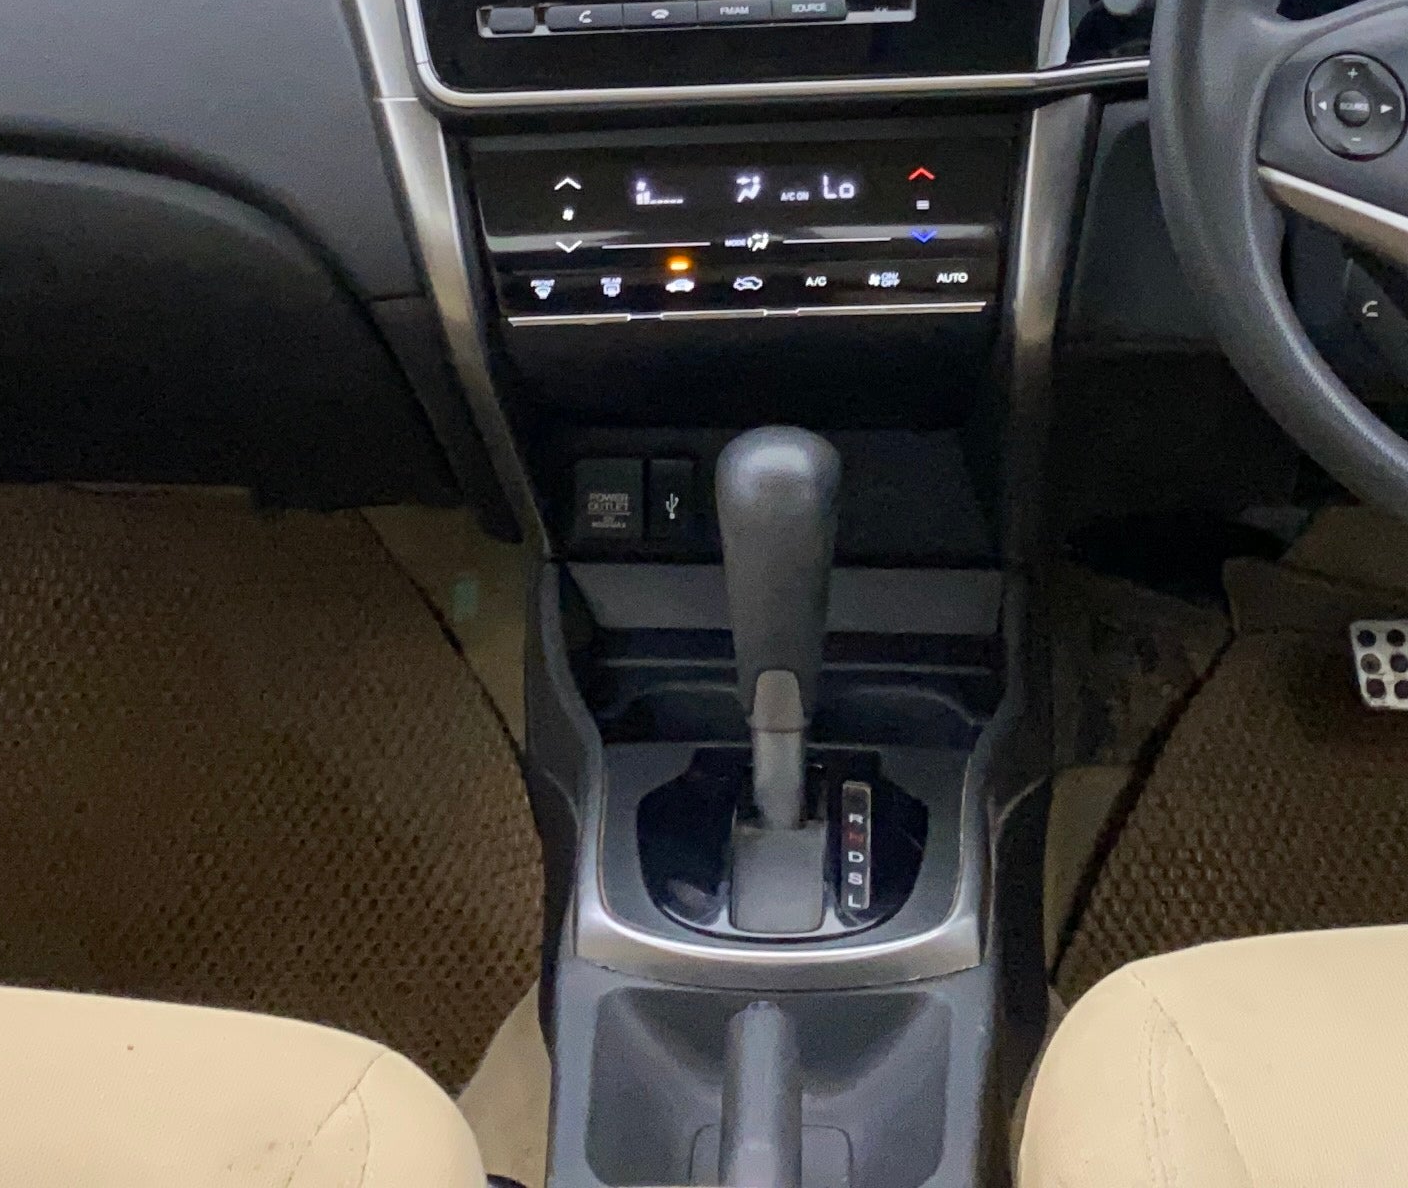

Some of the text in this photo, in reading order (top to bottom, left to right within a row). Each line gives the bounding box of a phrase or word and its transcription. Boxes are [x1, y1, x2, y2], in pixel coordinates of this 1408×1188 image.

[791, 2, 826, 13] SOURCE
[822, 174, 855, 200] Lo
[805, 276, 827, 287] A/C
[936, 272, 969, 284] AUTO
[847, 851, 865, 863] D
[847, 895, 862, 908] L
